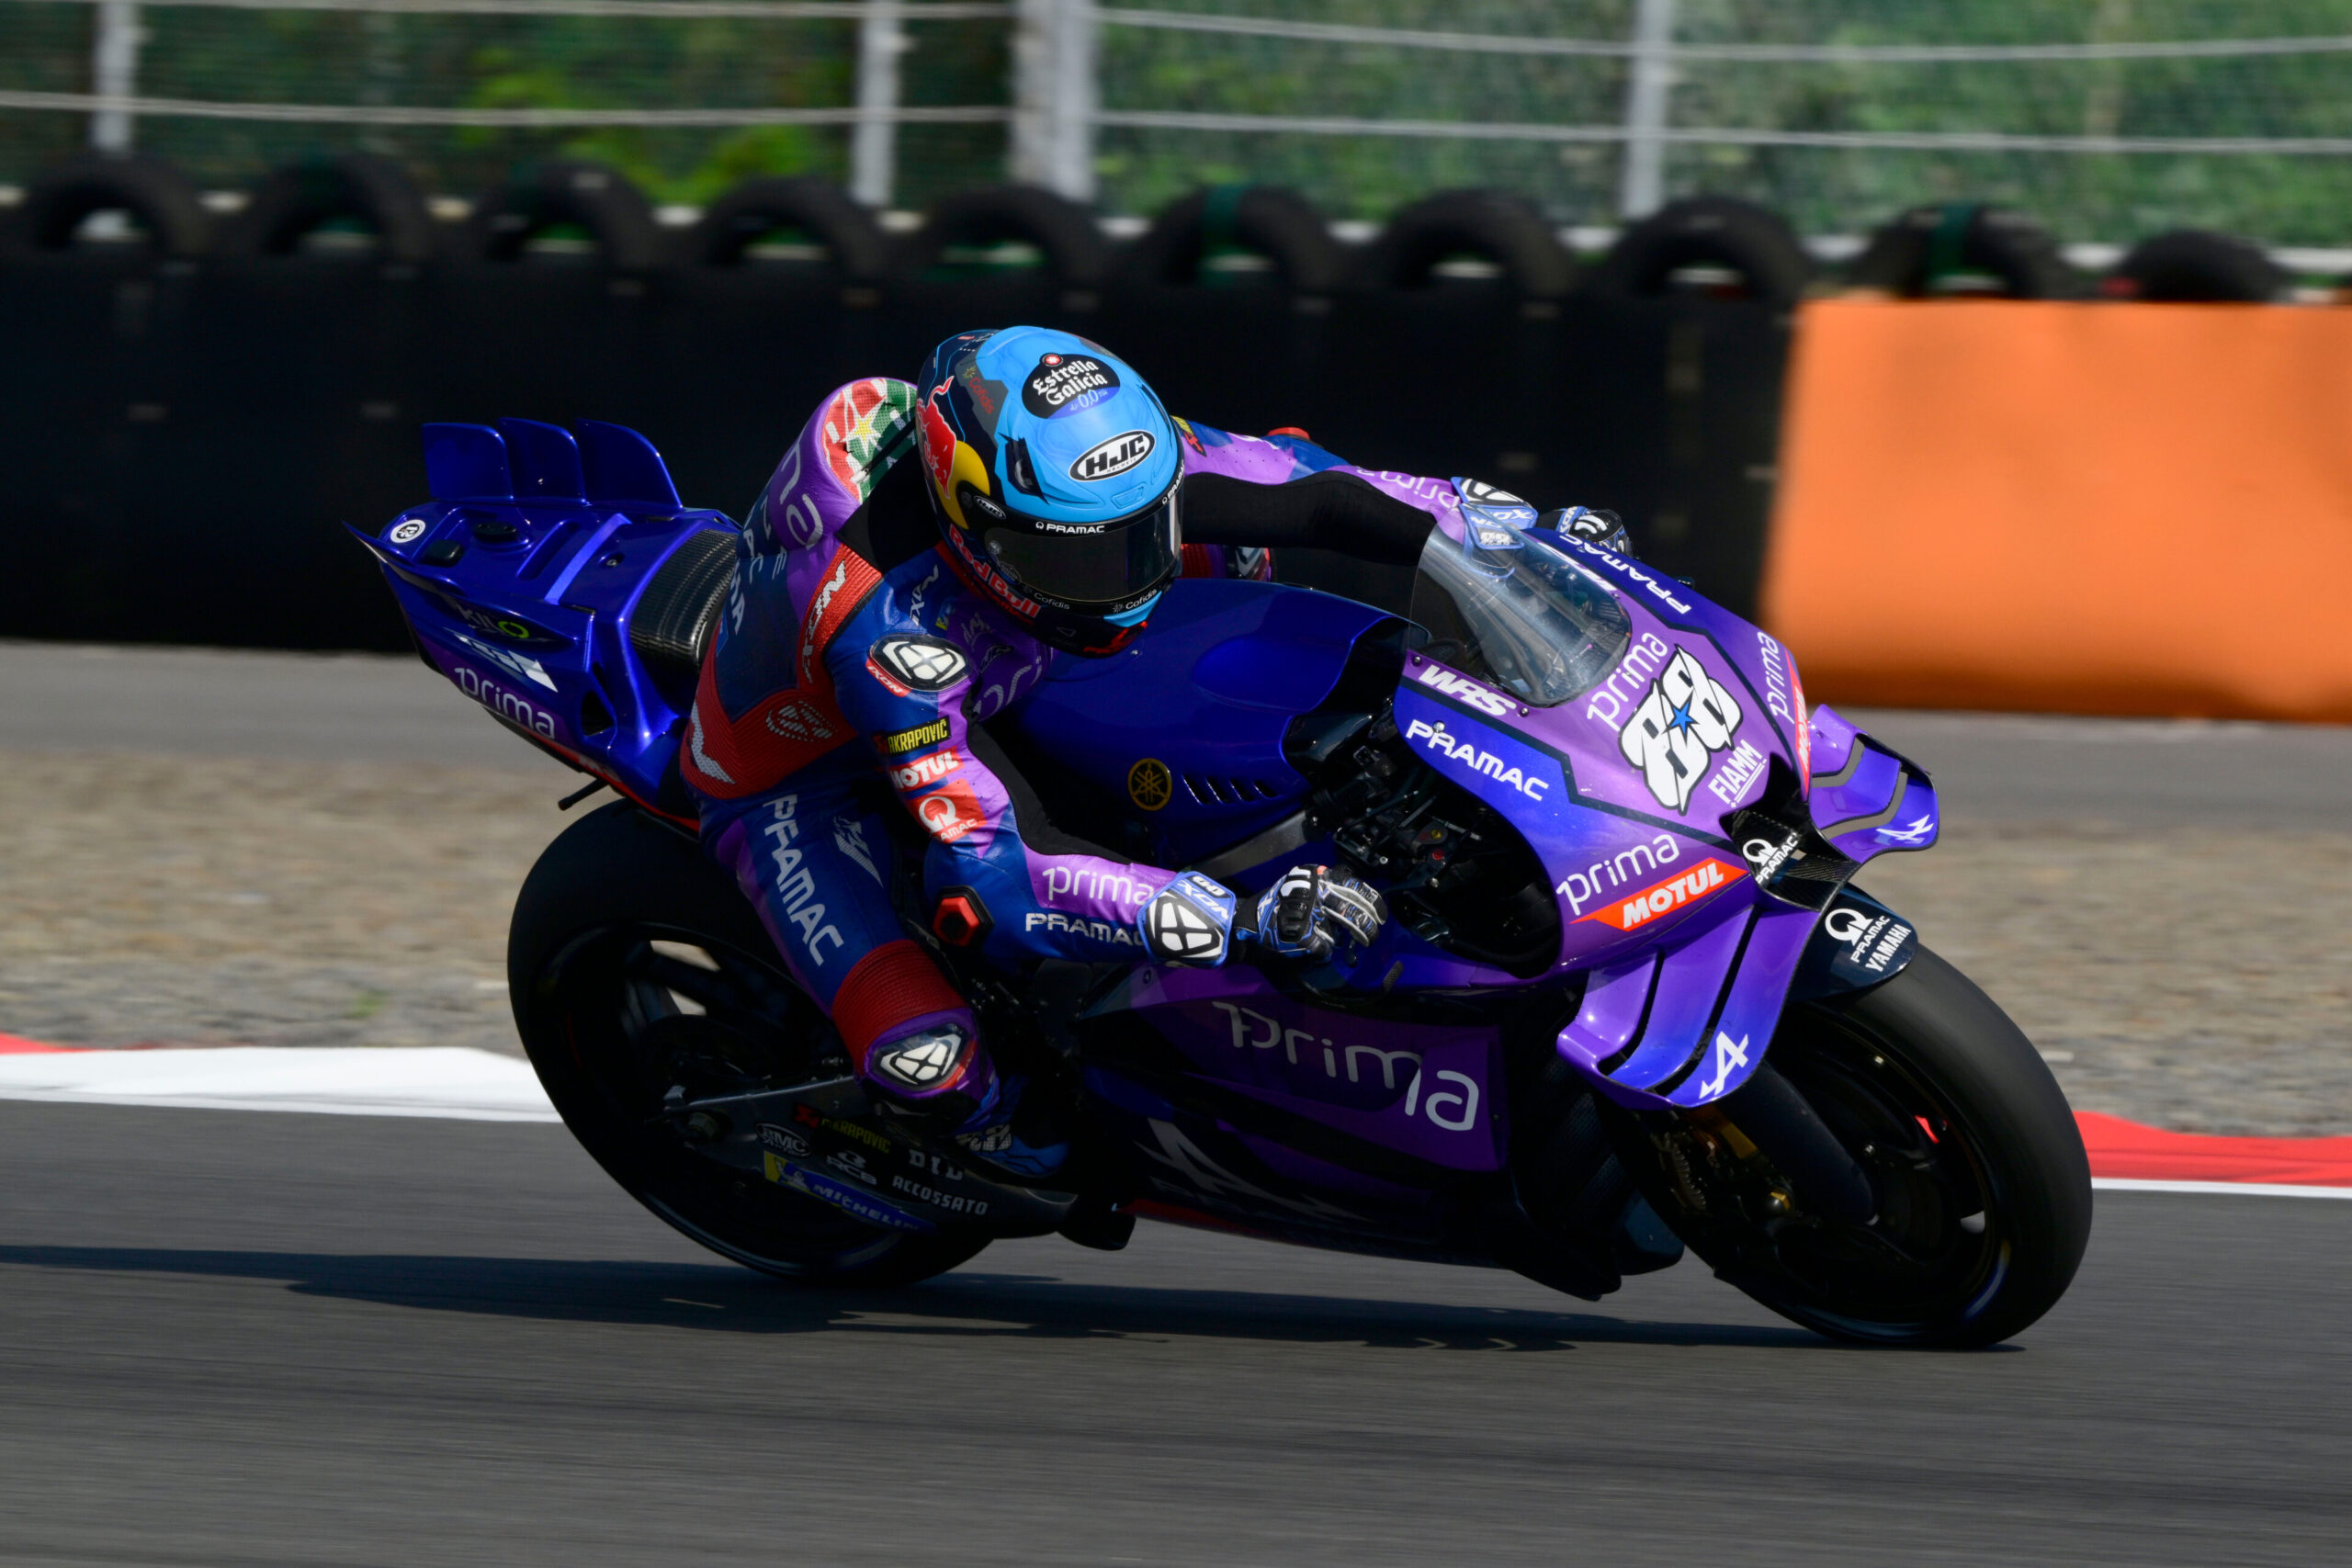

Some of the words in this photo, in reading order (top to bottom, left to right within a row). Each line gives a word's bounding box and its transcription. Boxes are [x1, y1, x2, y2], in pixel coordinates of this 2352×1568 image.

[1033, 360, 1100, 396] Estrella
[1046, 373, 1108, 405] Galicia
[1085, 434, 1146, 479] HJC
[1046, 524, 1105, 535] PRAMAC
[949, 523, 990, 581] Red
[989, 575, 1042, 618] Bull
[1559, 533, 1692, 615] PRAMAC
[1034, 592, 1070, 611] Cofidis
[1125, 589, 1158, 610] Cofidis
[454, 667, 556, 740] prima
[867, 664, 903, 694] IXON
[1419, 664, 1517, 716] WRS
[1587, 632, 1668, 732] prima
[1757, 631, 1795, 725] prima
[1619, 644, 1743, 816] 88
[1406, 719, 1550, 801] PRAMAC
[1707, 739, 1763, 805] FIAMM
[939, 817, 978, 842] AMAC
[1556, 833, 1680, 915] prima
[1755, 831, 1798, 889] PRAMAC
[1042, 867, 1154, 906] prima
[1623, 862, 1724, 929] MOTUL
[1850, 916, 1891, 964] PRAMAC
[1865, 923, 1913, 973] YAMAHA
[1213, 1000, 1481, 1132] prima
[762, 1126, 808, 1154] BMC
[892, 1175, 989, 1216] ACCOSSATO
